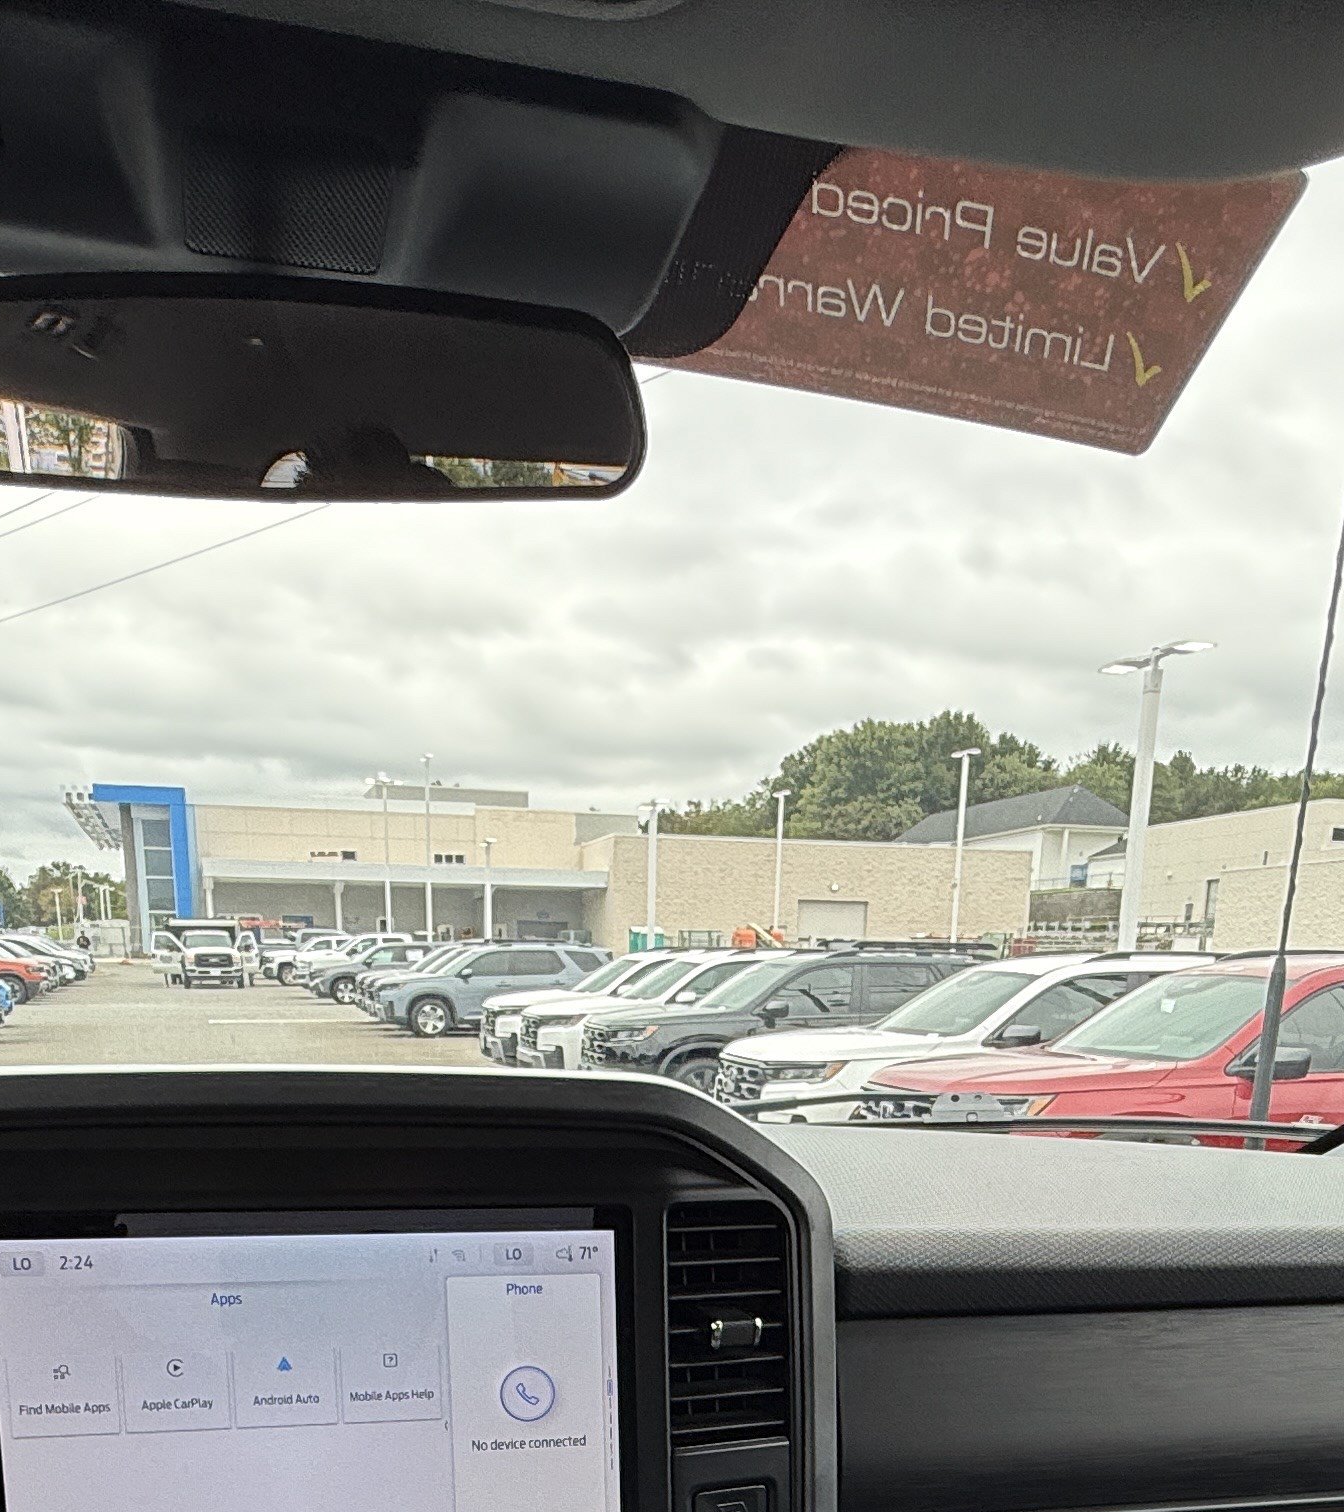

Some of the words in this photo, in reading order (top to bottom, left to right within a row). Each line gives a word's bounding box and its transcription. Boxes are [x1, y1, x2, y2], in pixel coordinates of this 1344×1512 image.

[506, 1248, 522, 1261] LO
[12, 1257, 32, 1271] LO
[59, 1255, 93, 1270] 2:24
[506, 1283, 543, 1296] Phone
[211, 1293, 243, 1307] Apps
[253, 1395, 293, 1406] Android
[295, 1394, 320, 1405] Auto
[349, 1391, 382, 1401] Mobile
[385, 1390, 410, 1402] Apps
[411, 1389, 434, 1401] Help
[19, 1404, 43, 1415] Find
[45, 1402, 81, 1414] Mobile
[83, 1402, 111, 1415] Apps
[141, 1399, 172, 1412] Apple
[173, 1398, 213, 1410] CarPlay
[472, 1439, 488, 1451] No
[490, 1438, 527, 1451] device
[528, 1434, 587, 1449] connected
